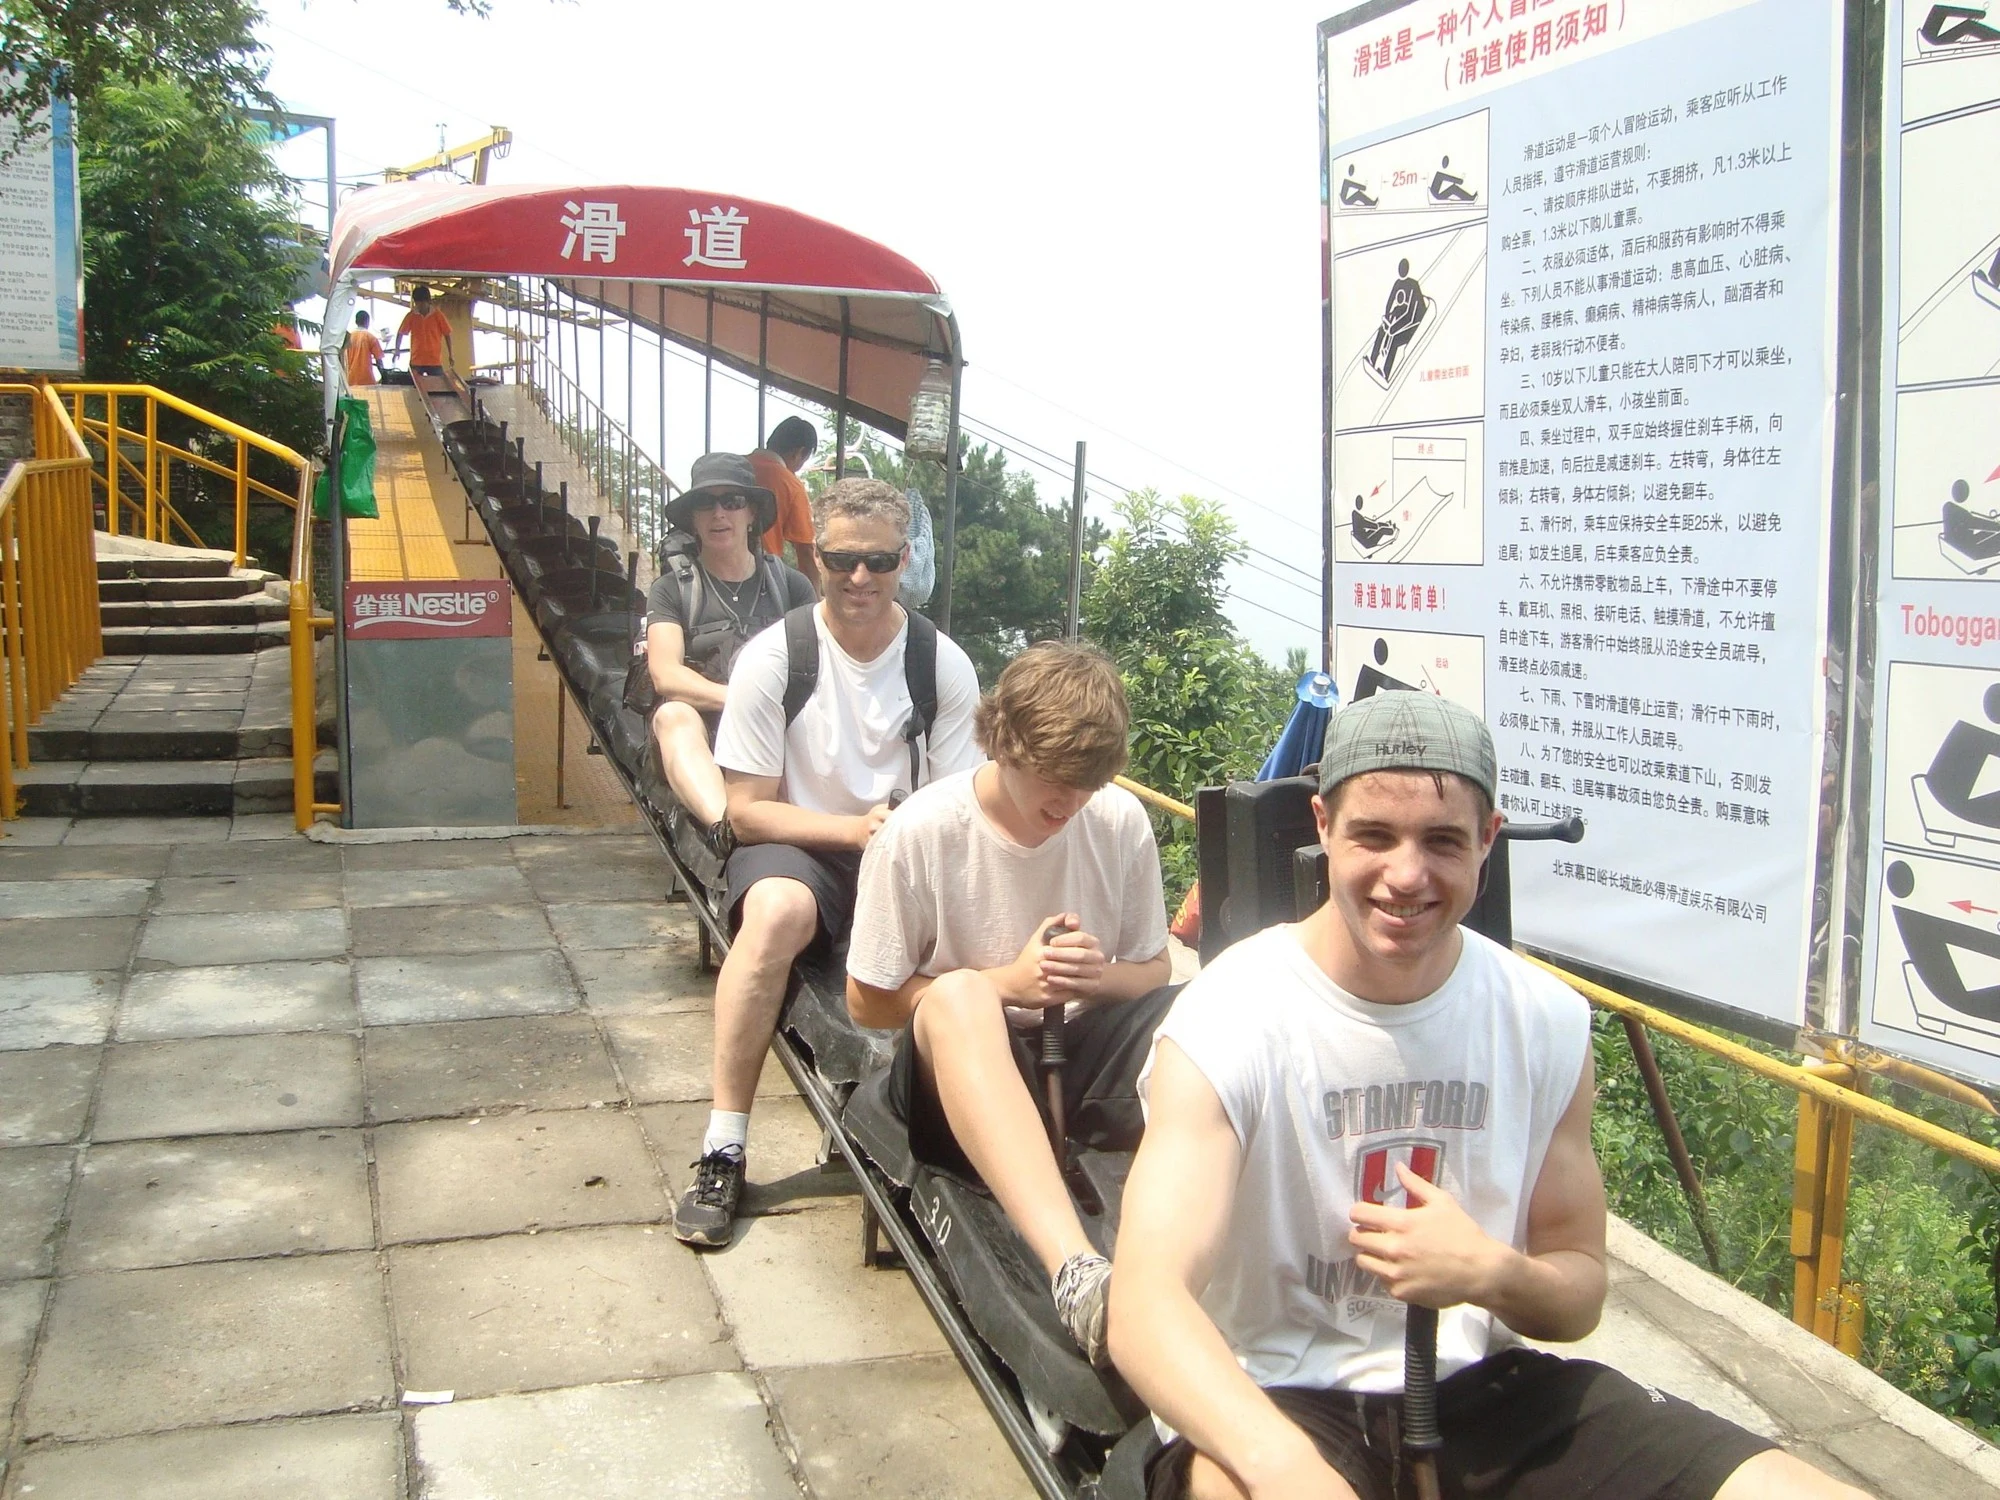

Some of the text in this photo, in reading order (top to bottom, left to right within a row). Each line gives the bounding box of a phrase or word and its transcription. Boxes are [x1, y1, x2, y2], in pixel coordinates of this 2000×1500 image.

[1392, 170, 1418, 187] 25m
[560, 200, 749, 269] 滑道
[353, 593, 402, 616] 雀巢
[1901, 604, 2000, 647] Tobogga
[1375, 740, 1428, 758] Hurley
[1323, 1080, 1489, 1141] STANFORD
